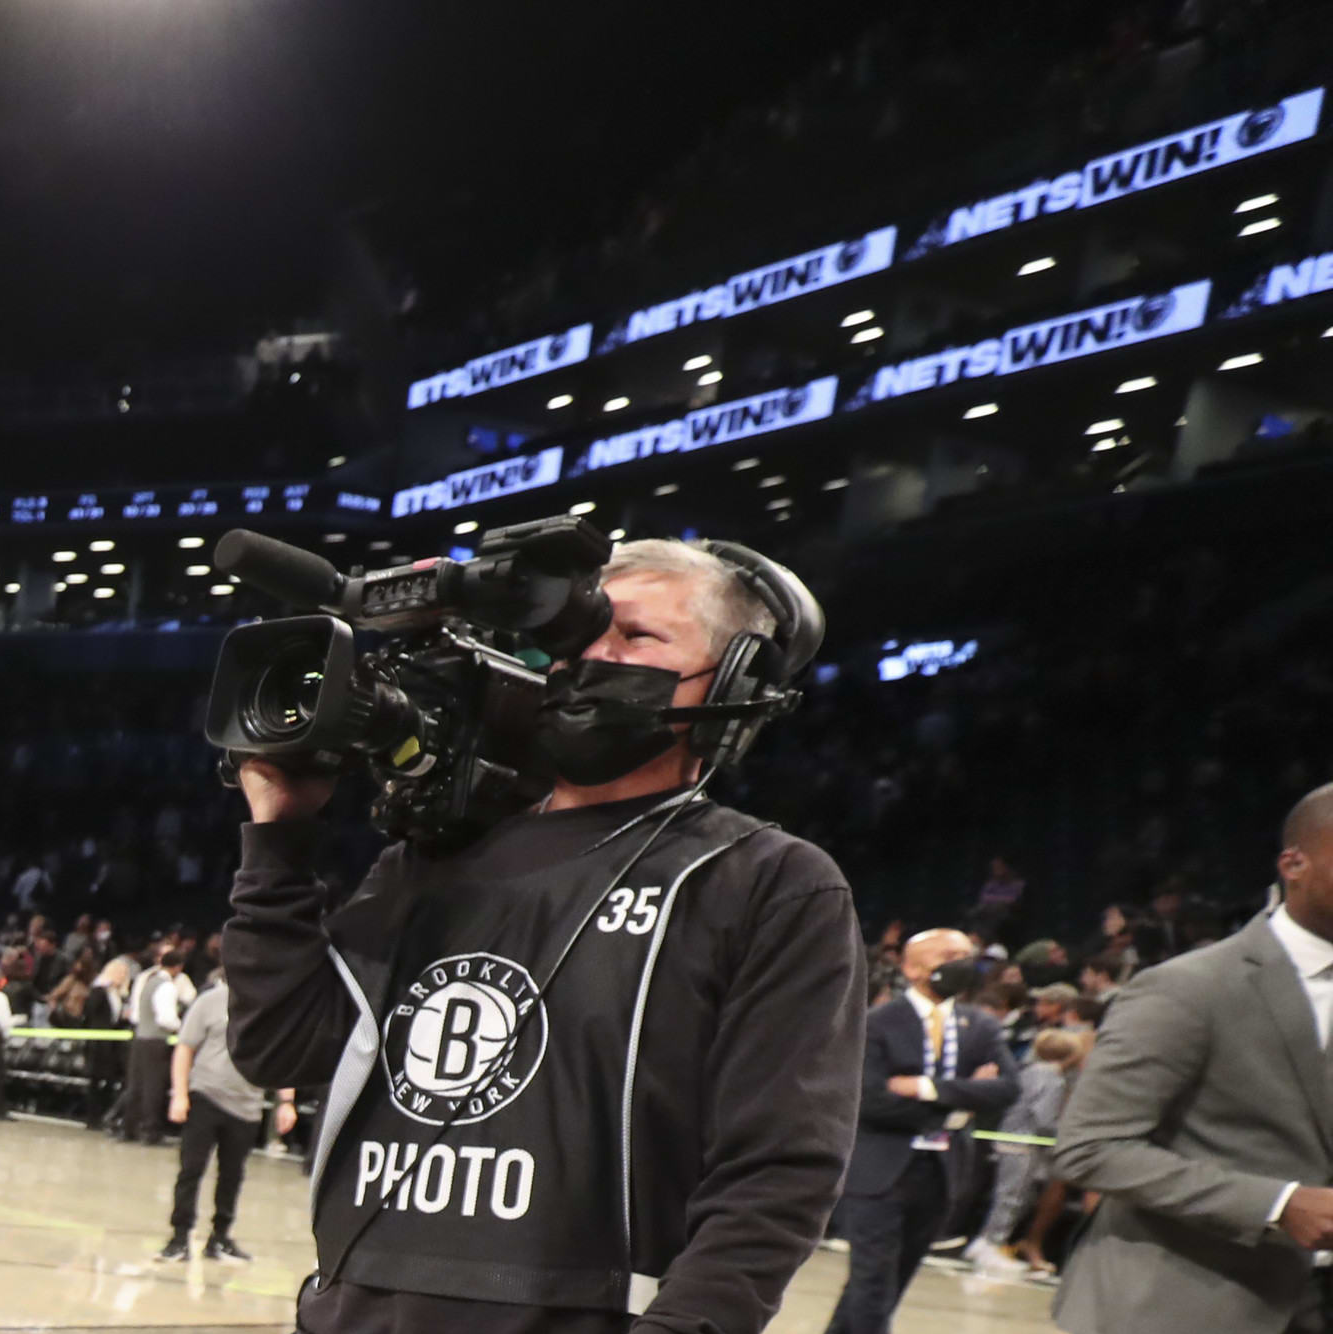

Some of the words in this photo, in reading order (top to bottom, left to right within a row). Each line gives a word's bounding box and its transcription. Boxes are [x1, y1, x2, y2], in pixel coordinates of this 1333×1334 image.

[943, 171, 1085, 246] NETS
[1092, 126, 1225, 196] WIN!
[626, 284, 730, 344] NETS
[732, 256, 825, 306] WIN!
[871, 338, 1006, 401] NETS
[1011, 307, 1136, 366] WIN!
[587, 419, 686, 470] NETS
[597, 886, 663, 935] 35
[396, 960, 534, 1017] BROOKLYN
[434, 997, 482, 1081] B
[354, 1140, 535, 1221] PHOTO
